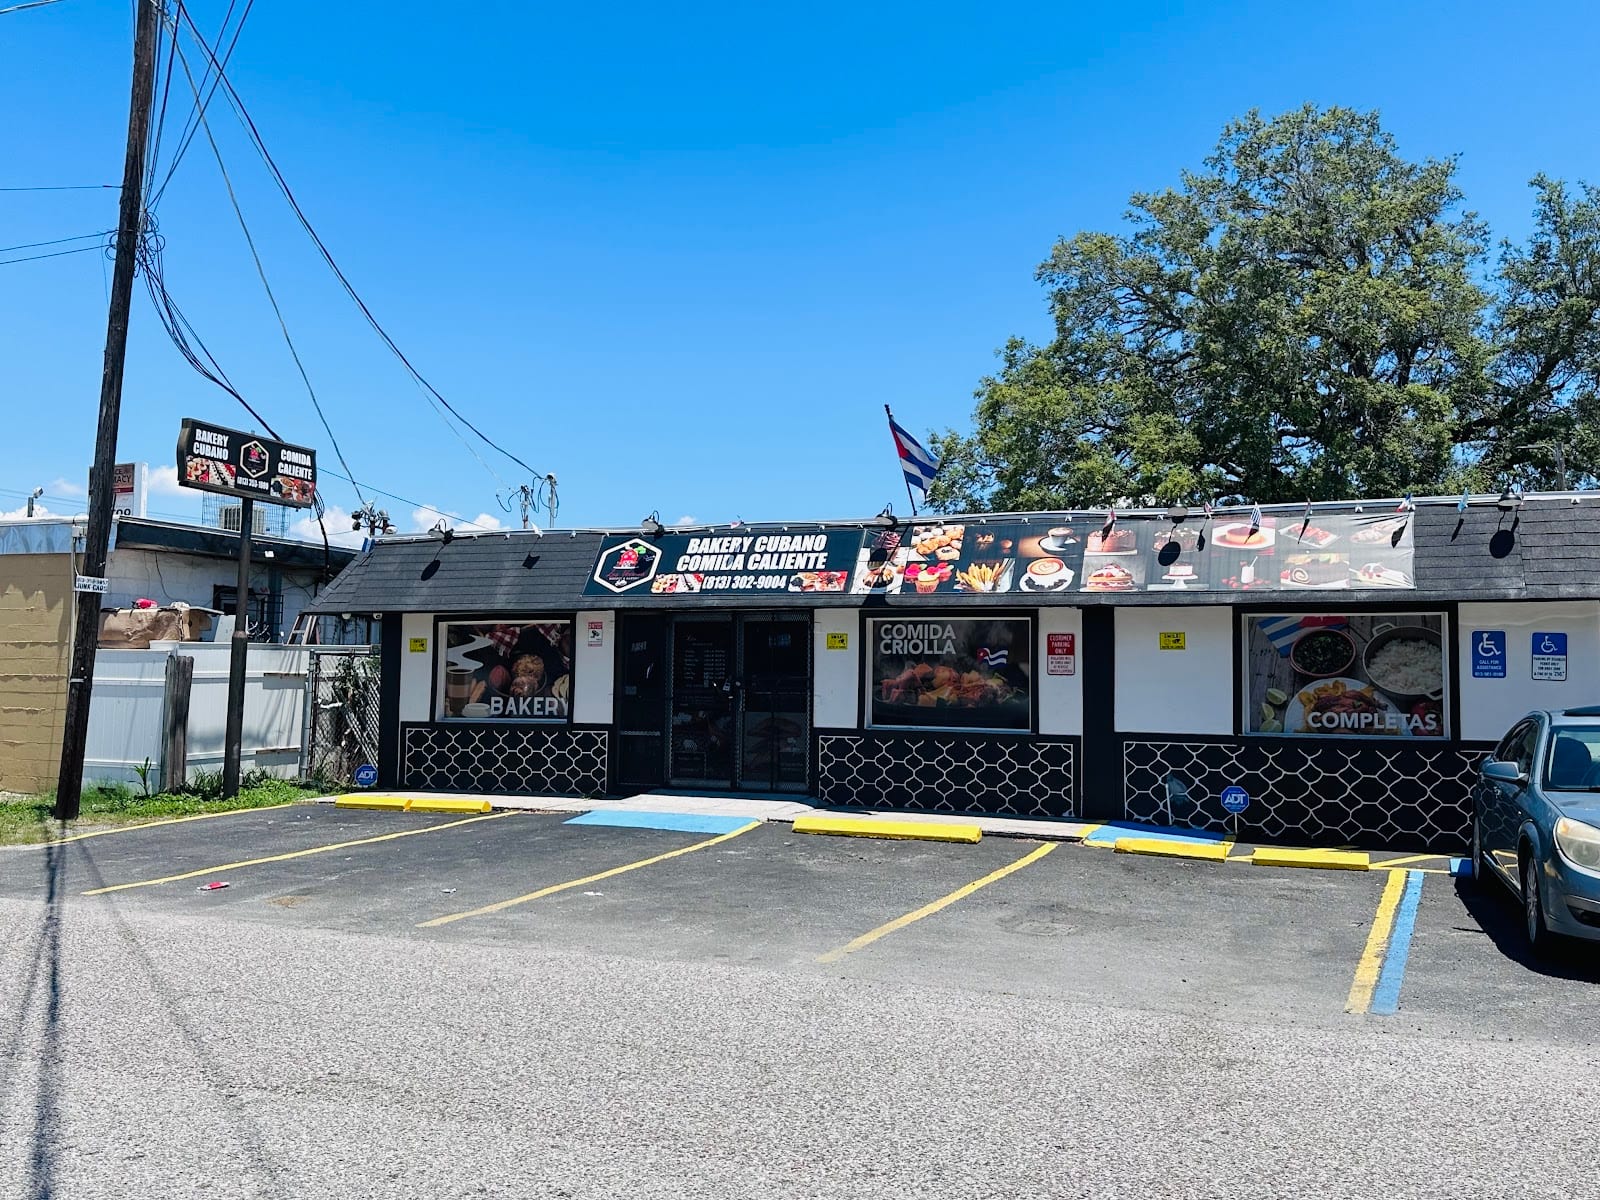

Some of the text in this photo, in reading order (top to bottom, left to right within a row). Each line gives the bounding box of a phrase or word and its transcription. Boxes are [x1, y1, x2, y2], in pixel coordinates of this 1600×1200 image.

[195, 429, 229, 447] BAKERY
[193, 442, 229, 460] CUBANO
[280, 449, 312, 466] COMIDA
[278, 462, 313, 480] CALIENTE
[686, 534, 828, 554] BAKERY CUBANO
[676, 552, 828, 571] COMIDA CALIENTE
[702, 574, 787, 590] (813) 302-9004
[880, 624, 956, 640] COMIDA
[880, 639, 956, 655] CRIOLLA
[490, 696, 569, 716] BAKERY
[1307, 711, 1438, 731] COMPLETAS
[357, 771, 376, 779] ADT
[1224, 793, 1246, 804] ADT
